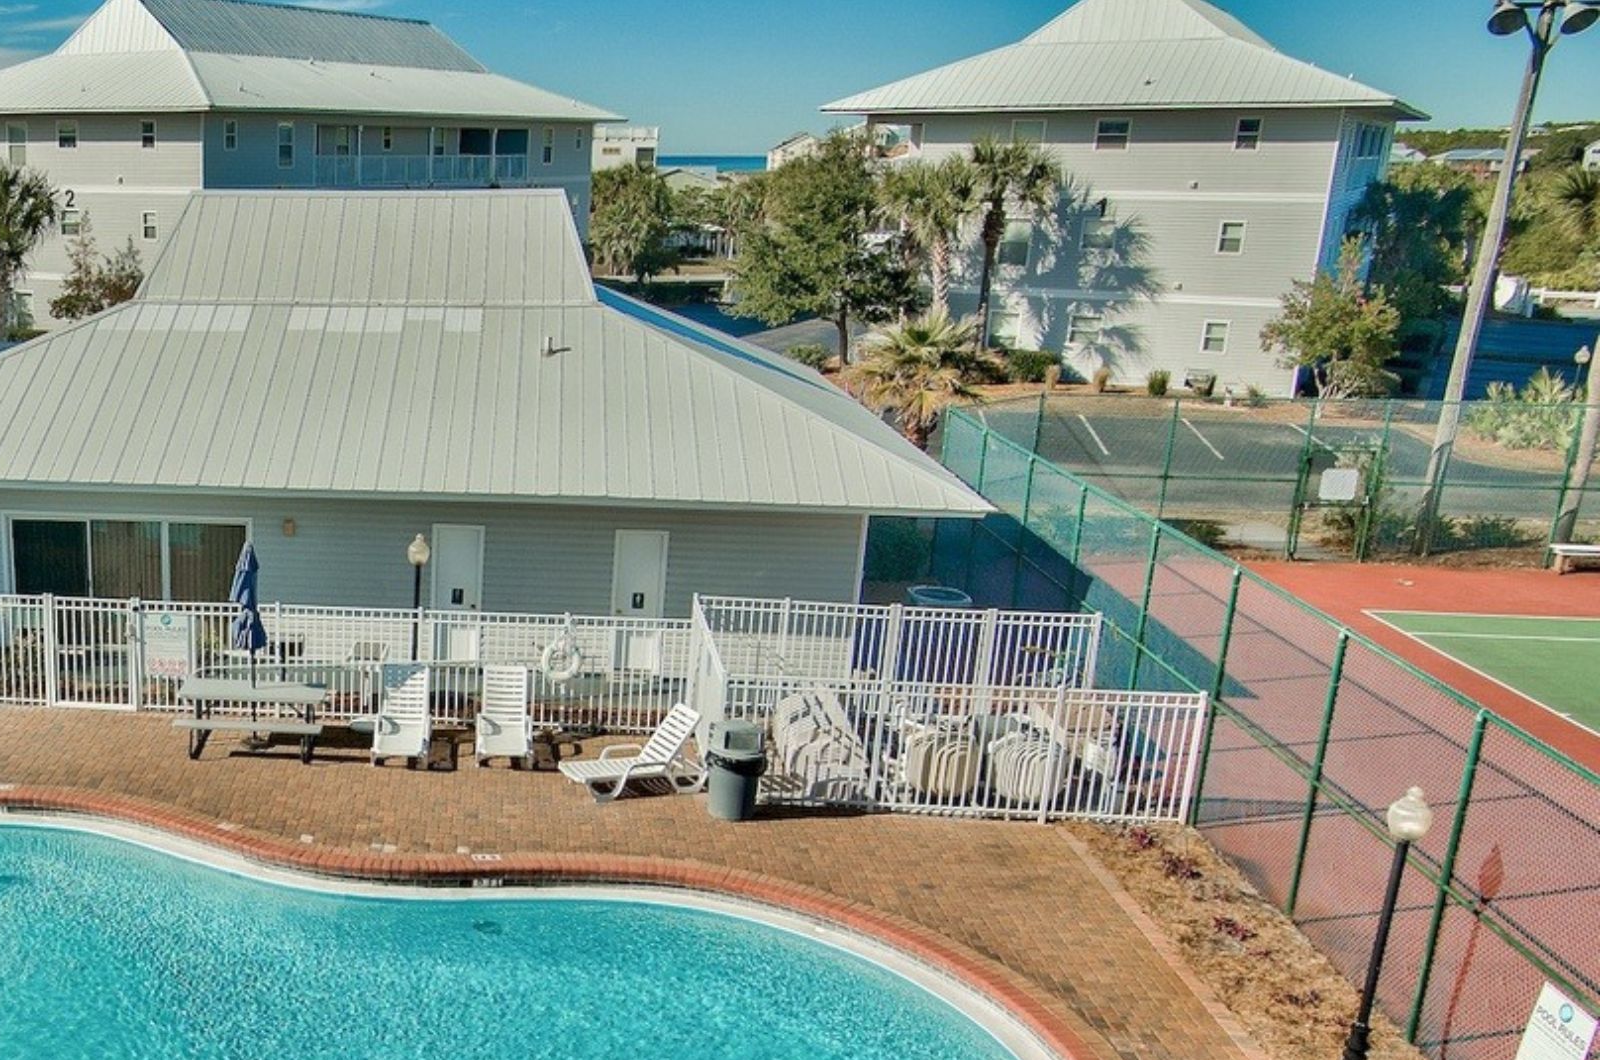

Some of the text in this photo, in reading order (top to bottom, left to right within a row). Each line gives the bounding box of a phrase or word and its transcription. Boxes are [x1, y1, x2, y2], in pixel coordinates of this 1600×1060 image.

[65, 190, 74, 207] 2
[1536, 1004, 1586, 1052] POOL RULES
